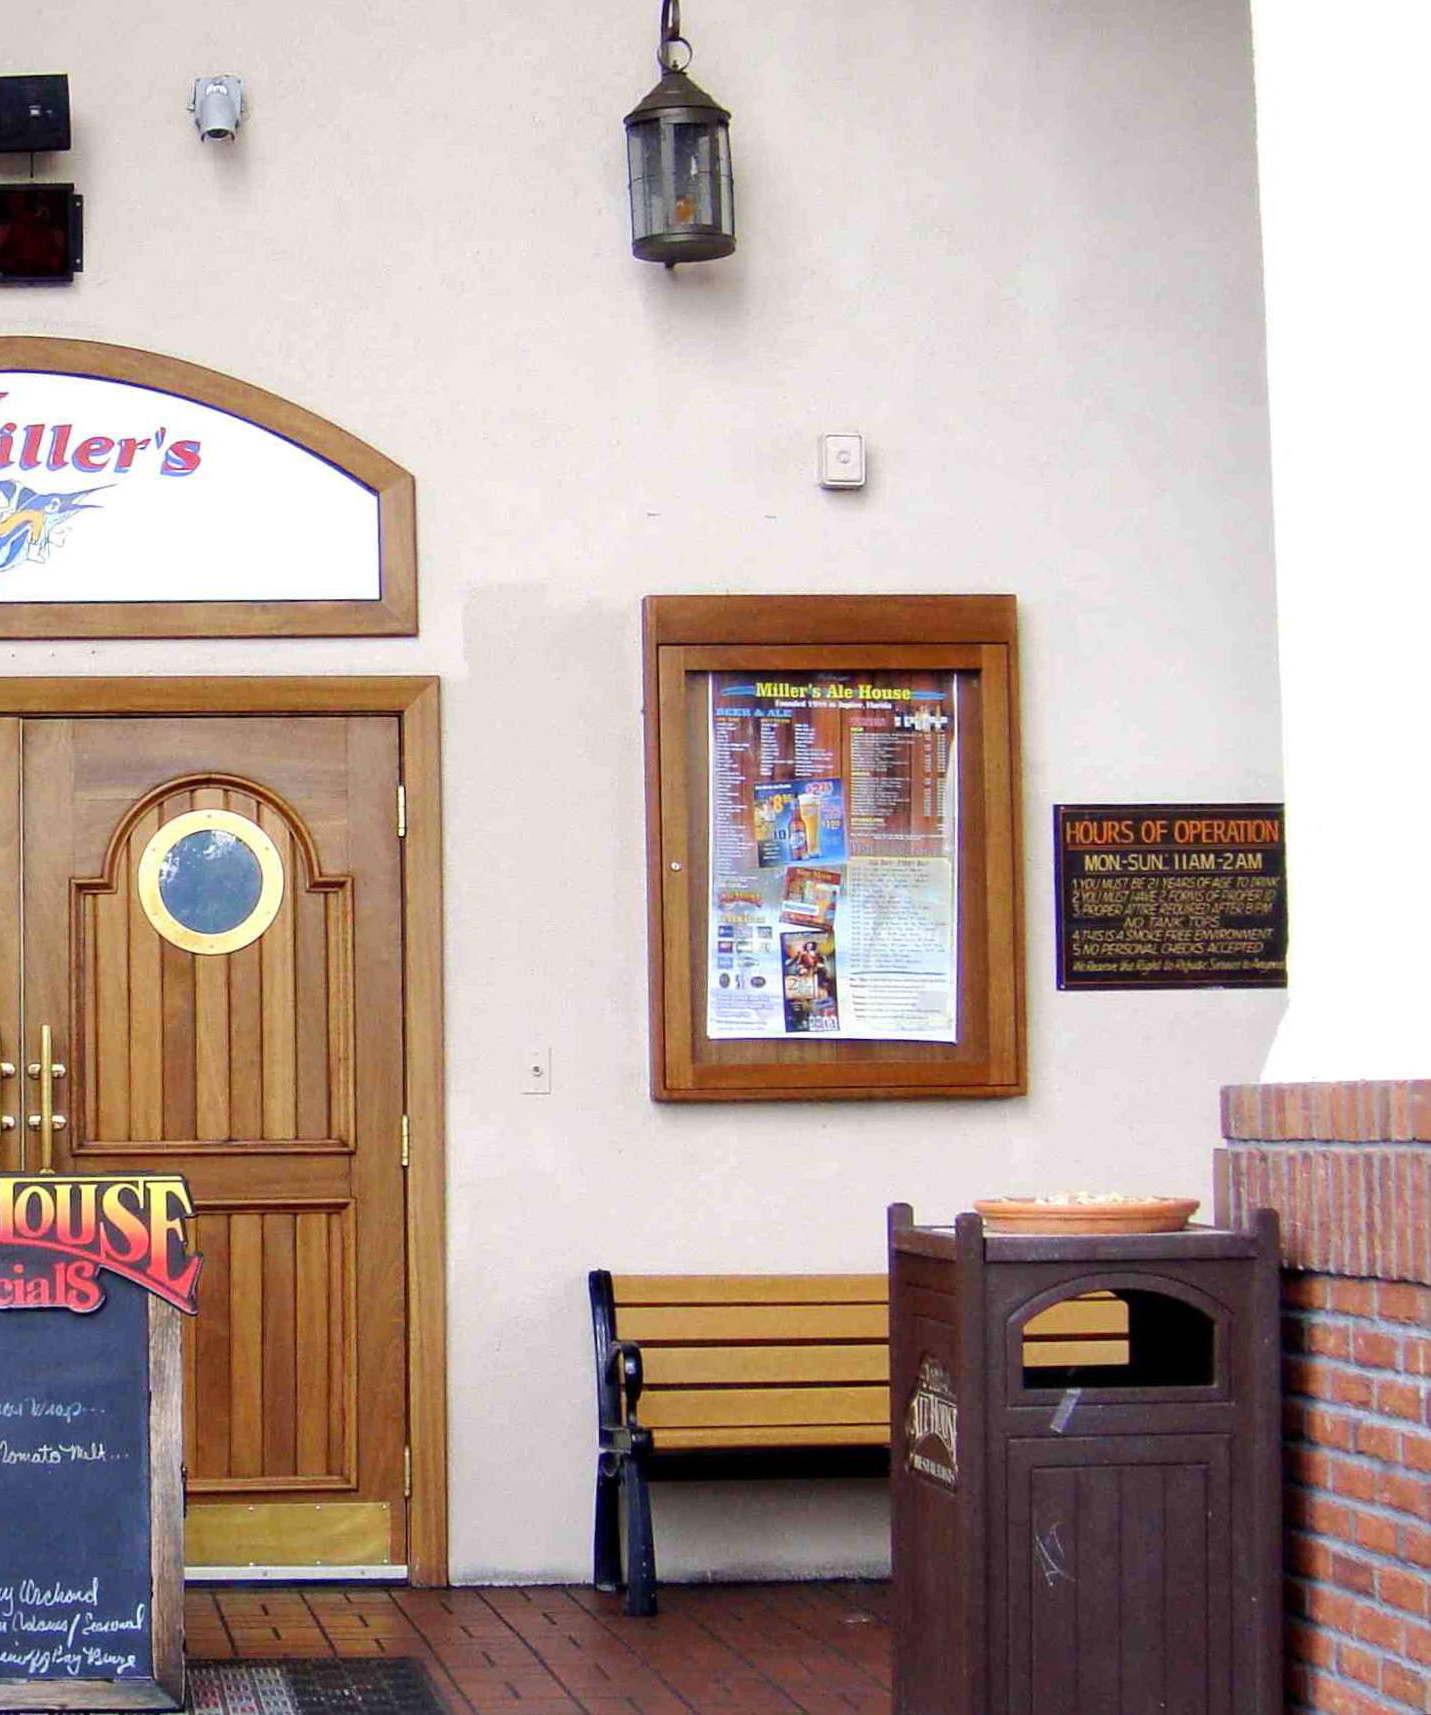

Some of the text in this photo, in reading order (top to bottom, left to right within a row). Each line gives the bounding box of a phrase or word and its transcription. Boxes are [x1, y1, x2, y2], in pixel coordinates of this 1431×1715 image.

[756, 682, 911, 700] Miller's Ale House
[716, 708, 793, 717] BEER & ALE
[1067, 820, 1279, 844] HOURS OF OPERATION
[1080, 878, 1100, 889] YOU
[1101, 878, 1128, 889] MUST
[1131, 878, 1146, 889] BE
[1162, 877, 1196, 889] YEARS
[1197, 877, 1212, 889] OF
[1212, 877, 1233, 889] AGE
[1236, 877, 1250, 888] TO
[1081, 891, 1102, 903] YOU
[1103, 891, 1128, 903] MUST
[1205, 890, 1221, 902] OF
[1082, 903, 1123, 916] PROPER
[1123, 916, 1221, 929] NO TANK TOPS
[1082, 929, 1103, 941] THIS
[1104, 929, 1115, 941] IS
[1116, 929, 1125, 940] A
[1125, 929, 1164, 941] SMOKE
[1164, 929, 1193, 941] FREE
[1194, 928, 1274, 940] ENVIRONMENT
[1083, 943, 1100, 955] NO
[1101, 943, 1158, 955] PERSONAL
[1161, 942, 1204, 955] CHECKS
[1207, 942, 1264, 954] ACCEPTED
